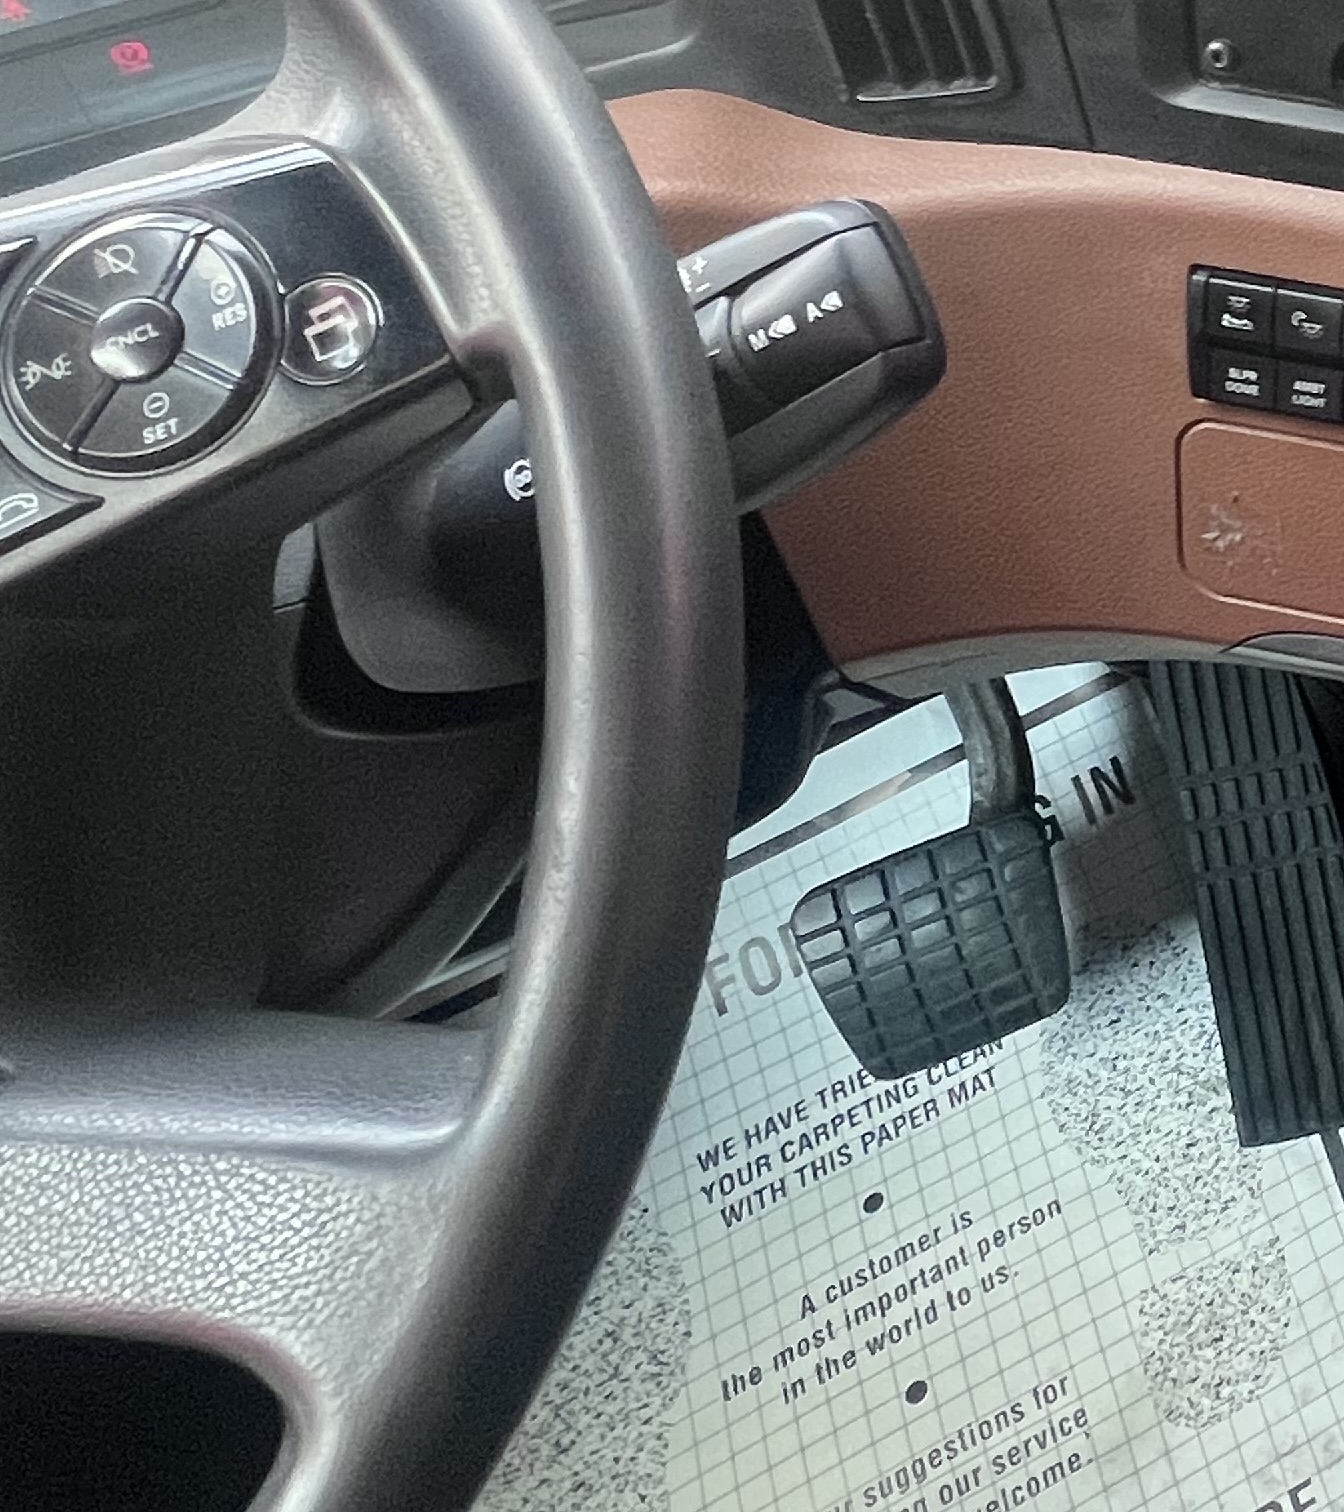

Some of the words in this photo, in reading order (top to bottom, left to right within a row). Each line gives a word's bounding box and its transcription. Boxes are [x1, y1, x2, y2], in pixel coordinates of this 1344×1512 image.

[212, 302, 248, 331] RES
[142, 417, 178, 444] SET
[1071, 756, 1136, 825] IN
[696, 1136, 738, 1173] WE
[744, 1099, 809, 1149] HAVE
[815, 1068, 873, 1109] TRIE
[700, 1154, 772, 1204] YOUR
[780, 1076, 920, 1163] CARPETING
[926, 1040, 1004, 1086] CLEAN
[720, 1176, 787, 1228] WITH
[793, 1143, 853, 1188] THIS
[860, 1098, 940, 1155] PAPER
[947, 1066, 997, 1109] MAT
[721, 1366, 763, 1402] the
[772, 1318, 835, 1372] most
[843, 1246, 969, 1332] important
[977, 1199, 1062, 1262] person
[800, 1293, 817, 1320] A
[825, 1226, 941, 1304] customer
[950, 1210, 973, 1235] is
[781, 1377, 806, 1405] in
[815, 1349, 857, 1385] the
[865, 1299, 939, 1356] world
[946, 1287, 972, 1312] to
[981, 1264, 1019, 1293] us.
[863, 1402, 1025, 1508] suggestions
[1032, 1376, 1067, 1410] for
[939, 1465, 981, 1506] our
[977, 1452, 1093, 1512] elcome.
